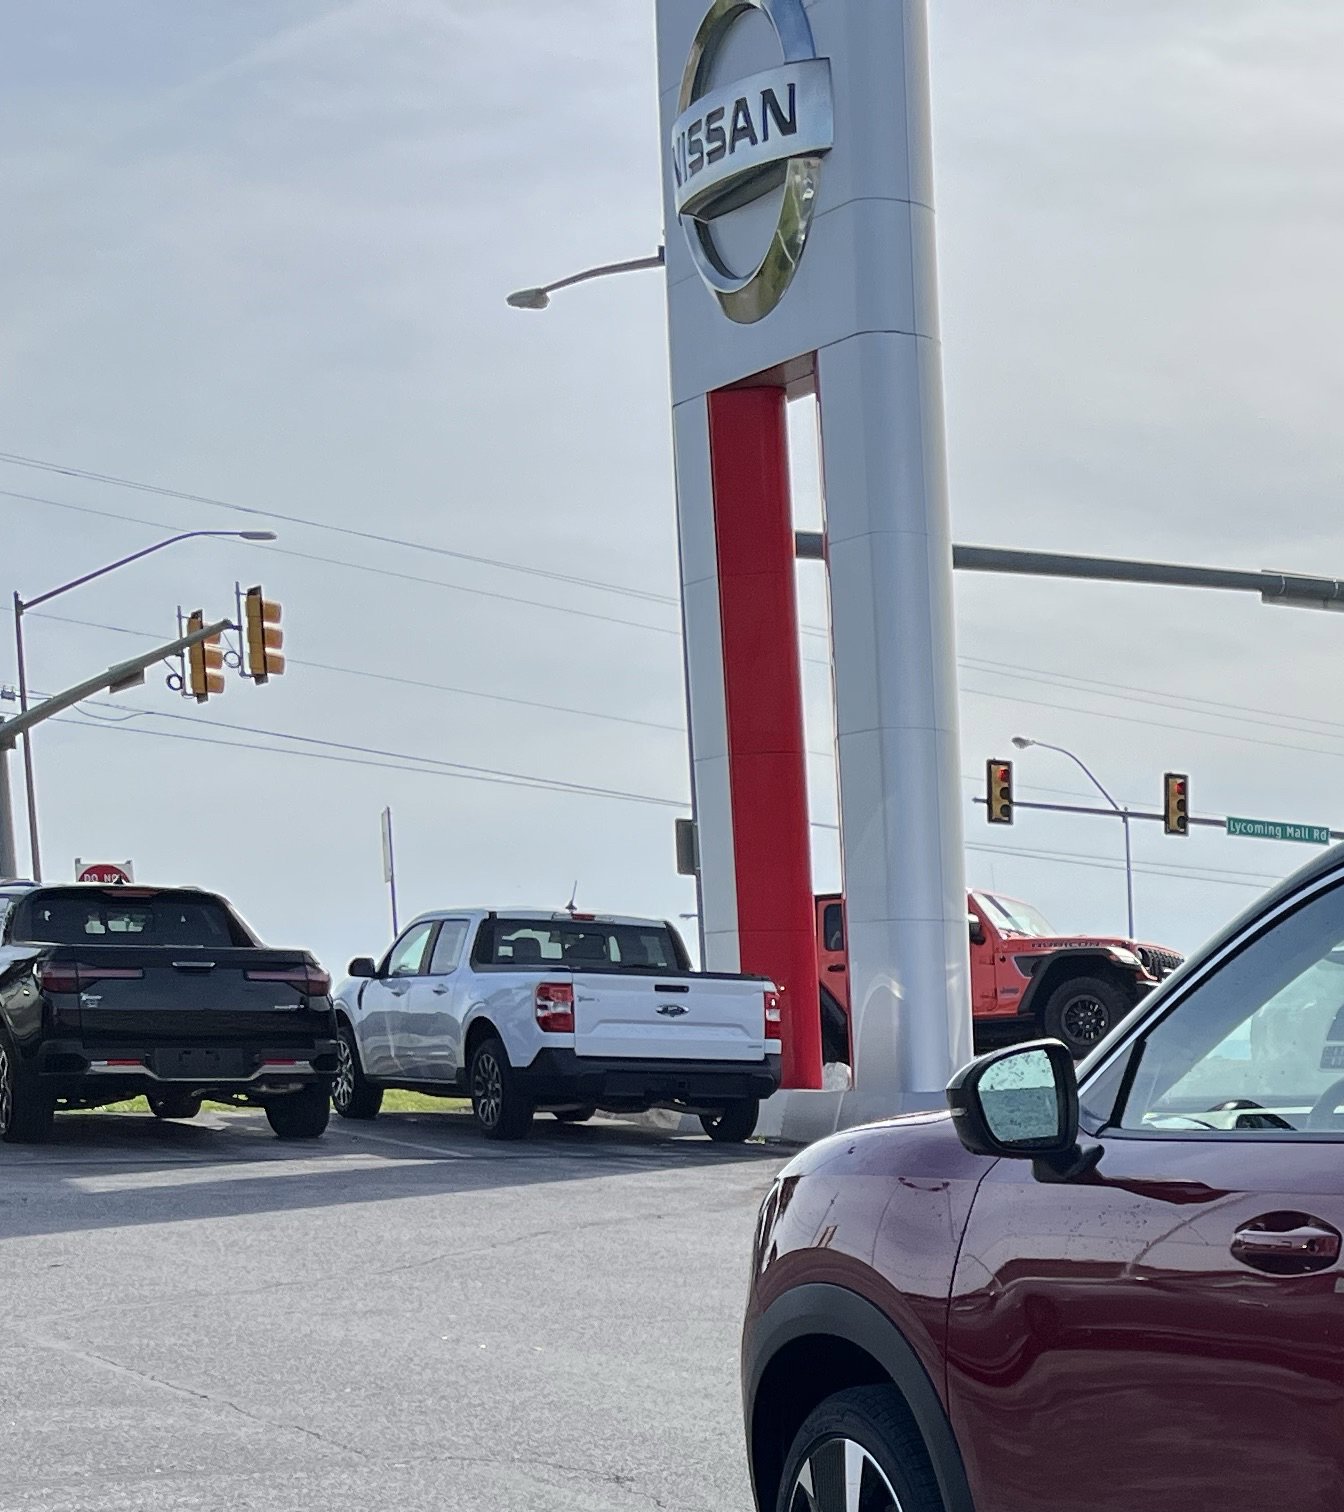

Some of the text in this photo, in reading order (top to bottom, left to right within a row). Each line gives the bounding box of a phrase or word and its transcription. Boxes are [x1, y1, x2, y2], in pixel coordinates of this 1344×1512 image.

[672, 83, 797, 188] NISSAN
[1230, 820, 1327, 841] Lycoming Mall Rd
[84, 873, 122, 882] DO NO
